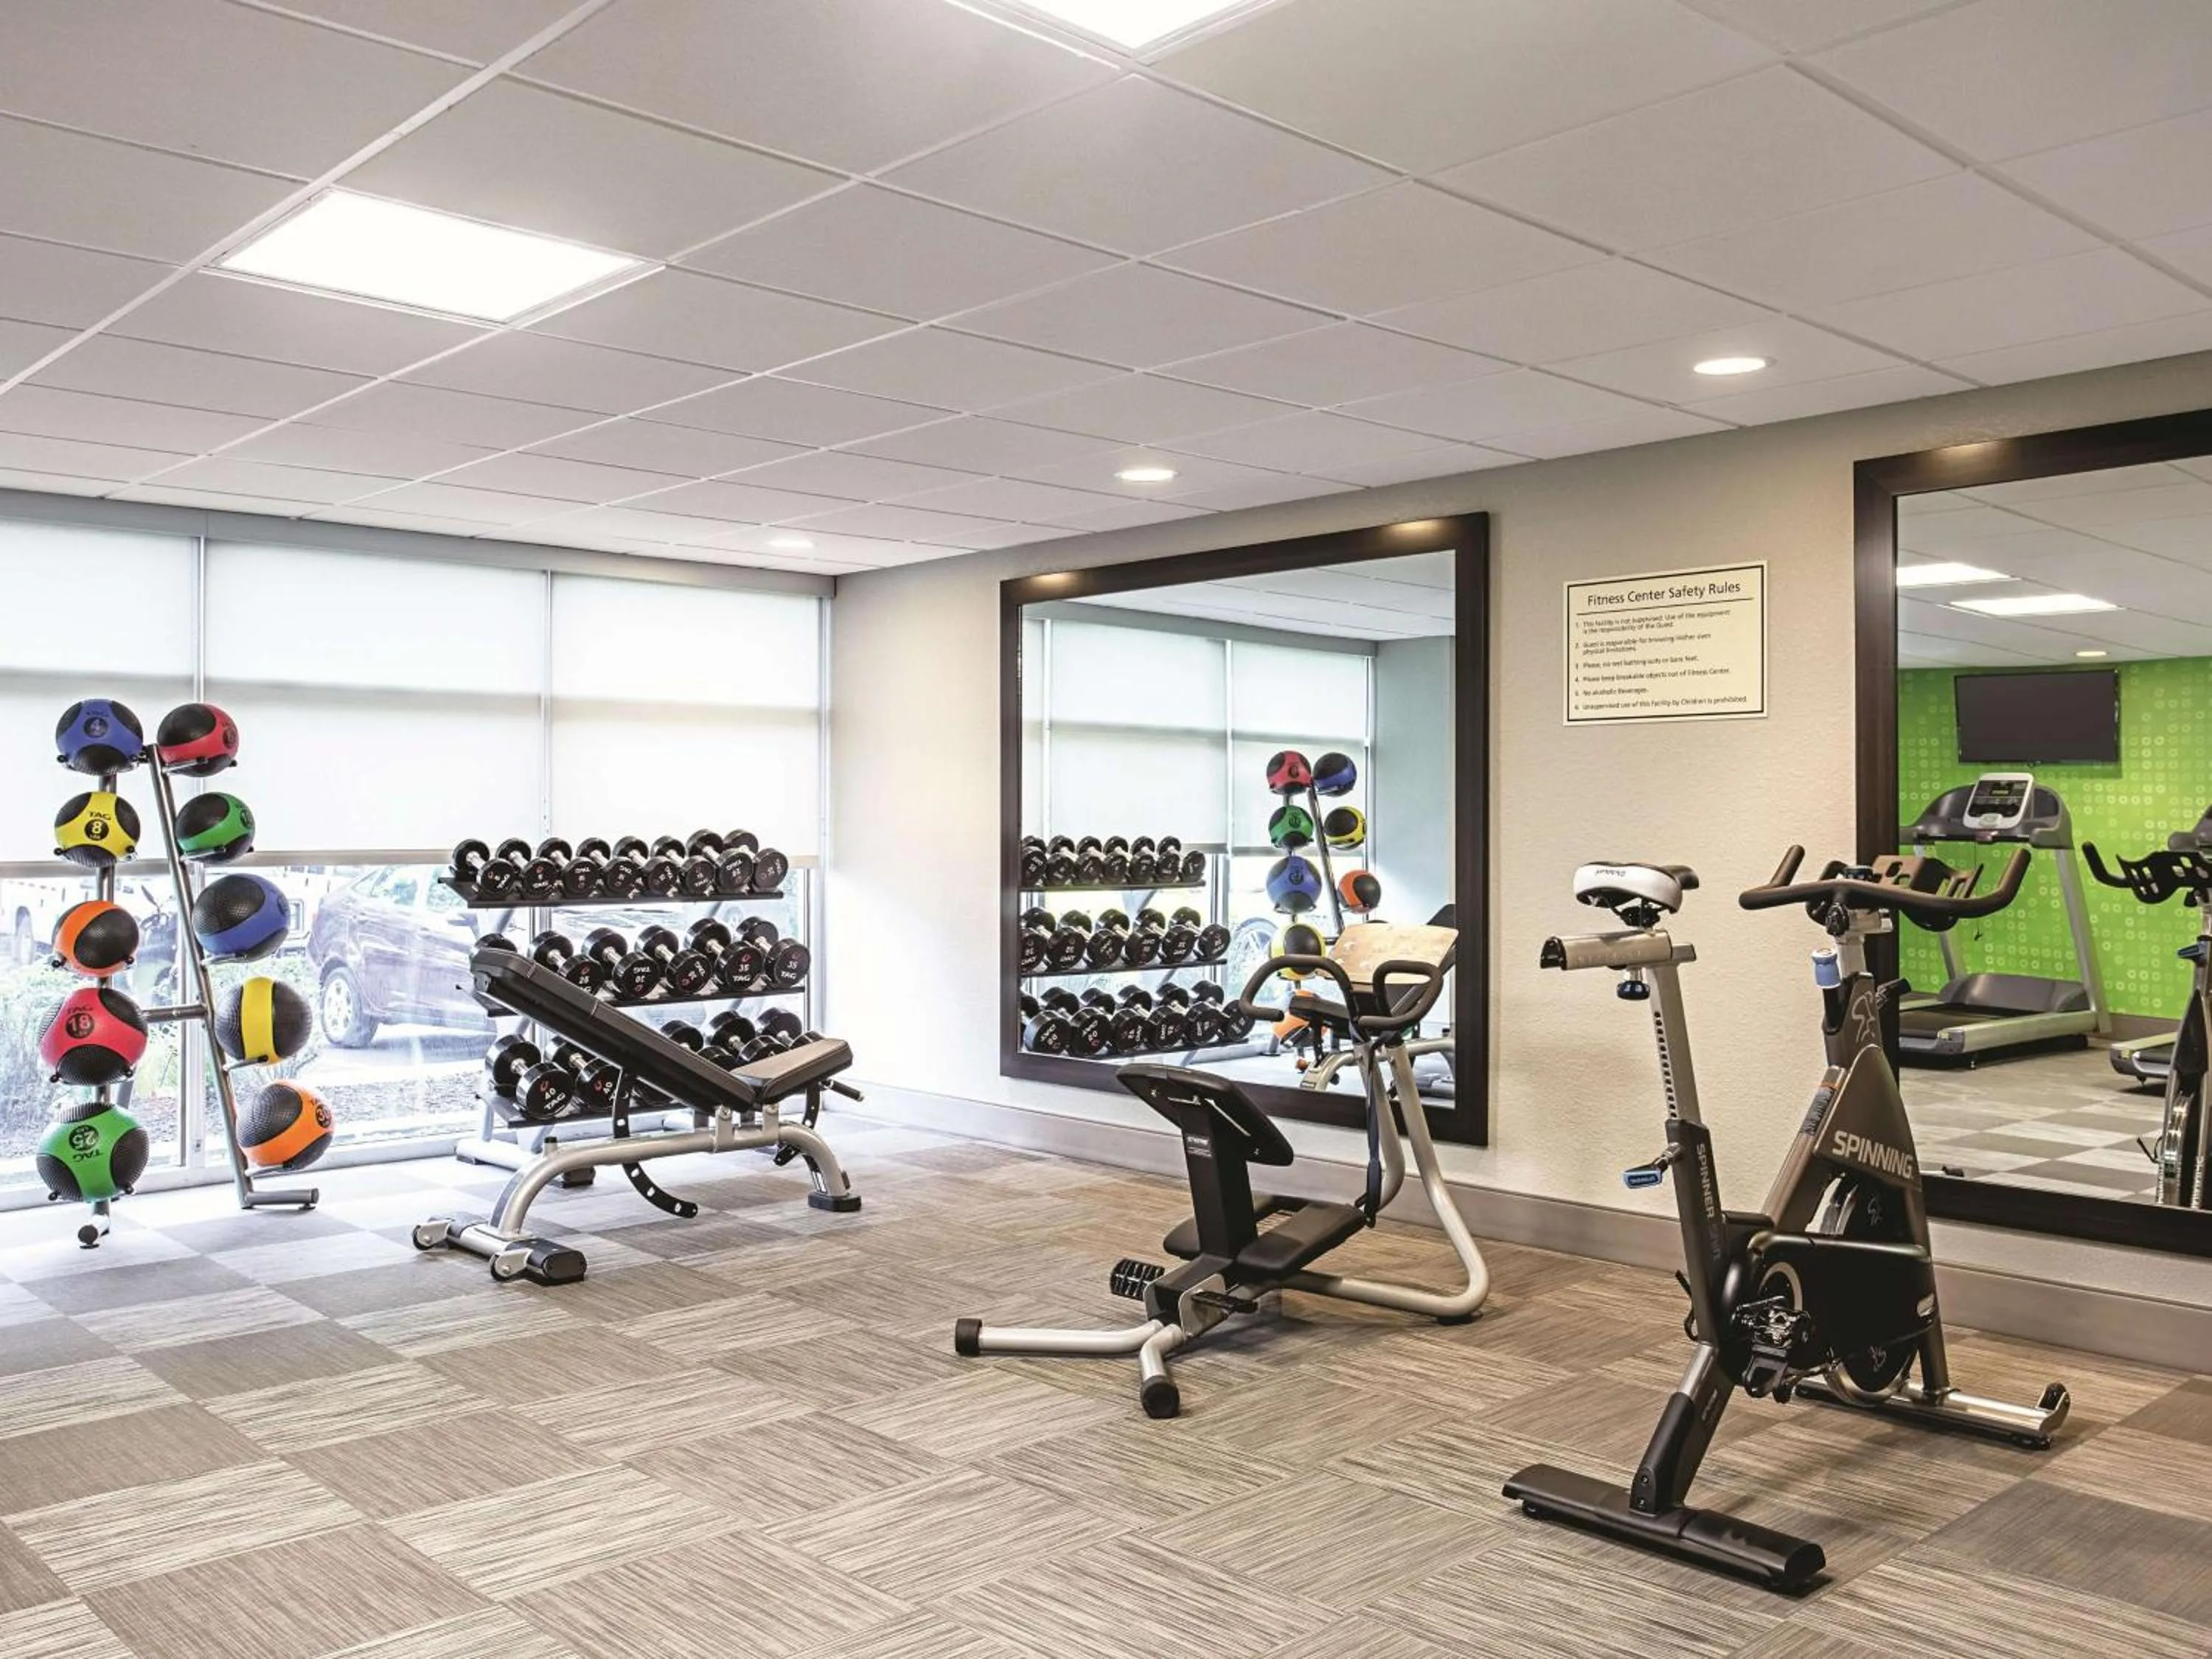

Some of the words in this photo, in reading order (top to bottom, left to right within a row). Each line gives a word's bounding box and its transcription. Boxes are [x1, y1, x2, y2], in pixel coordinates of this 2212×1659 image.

[1587, 594, 1624, 606] Fitness
[1627, 590, 1666, 602] Center
[1669, 585, 1705, 599] Safety
[1708, 582, 1741, 594] Rules
[89, 811, 111, 821] TAG
[92, 821, 102, 834] 8
[780, 970, 797, 980] TAG
[67, 1004, 94, 1014] TAG
[68, 1015, 91, 1032] 18
[543, 1092, 566, 1110] TAG
[72, 1131, 96, 1150] 25
[72, 1150, 103, 1163] TAG
[1832, 1130, 1915, 1180] SPINNING
[1697, 1143, 1716, 1219] SPINNER
